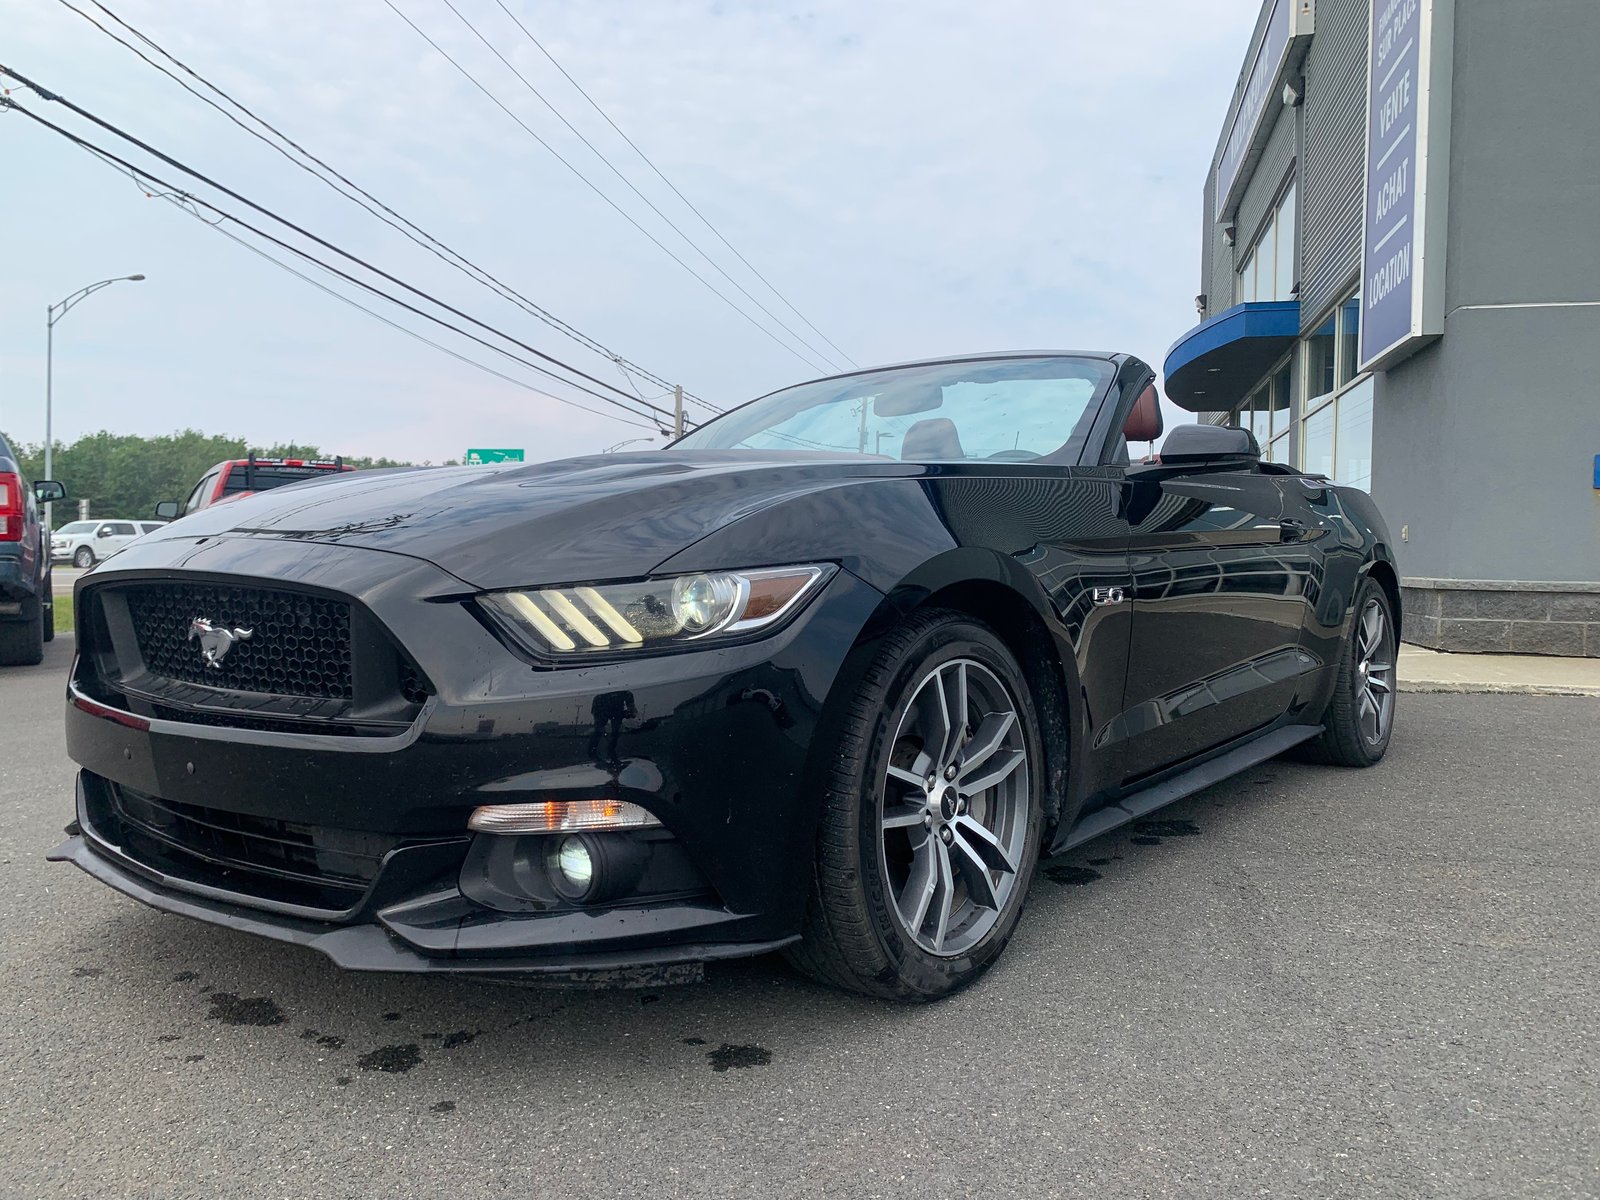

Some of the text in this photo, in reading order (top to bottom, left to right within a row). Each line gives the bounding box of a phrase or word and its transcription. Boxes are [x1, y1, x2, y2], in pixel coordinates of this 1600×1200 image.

[1378, 0, 1416, 67] SUR PLACE
[1380, 68, 1410, 138] VENTE
[1375, 156, 1409, 225] ACHAT
[1368, 242, 1410, 310] LOCATION
